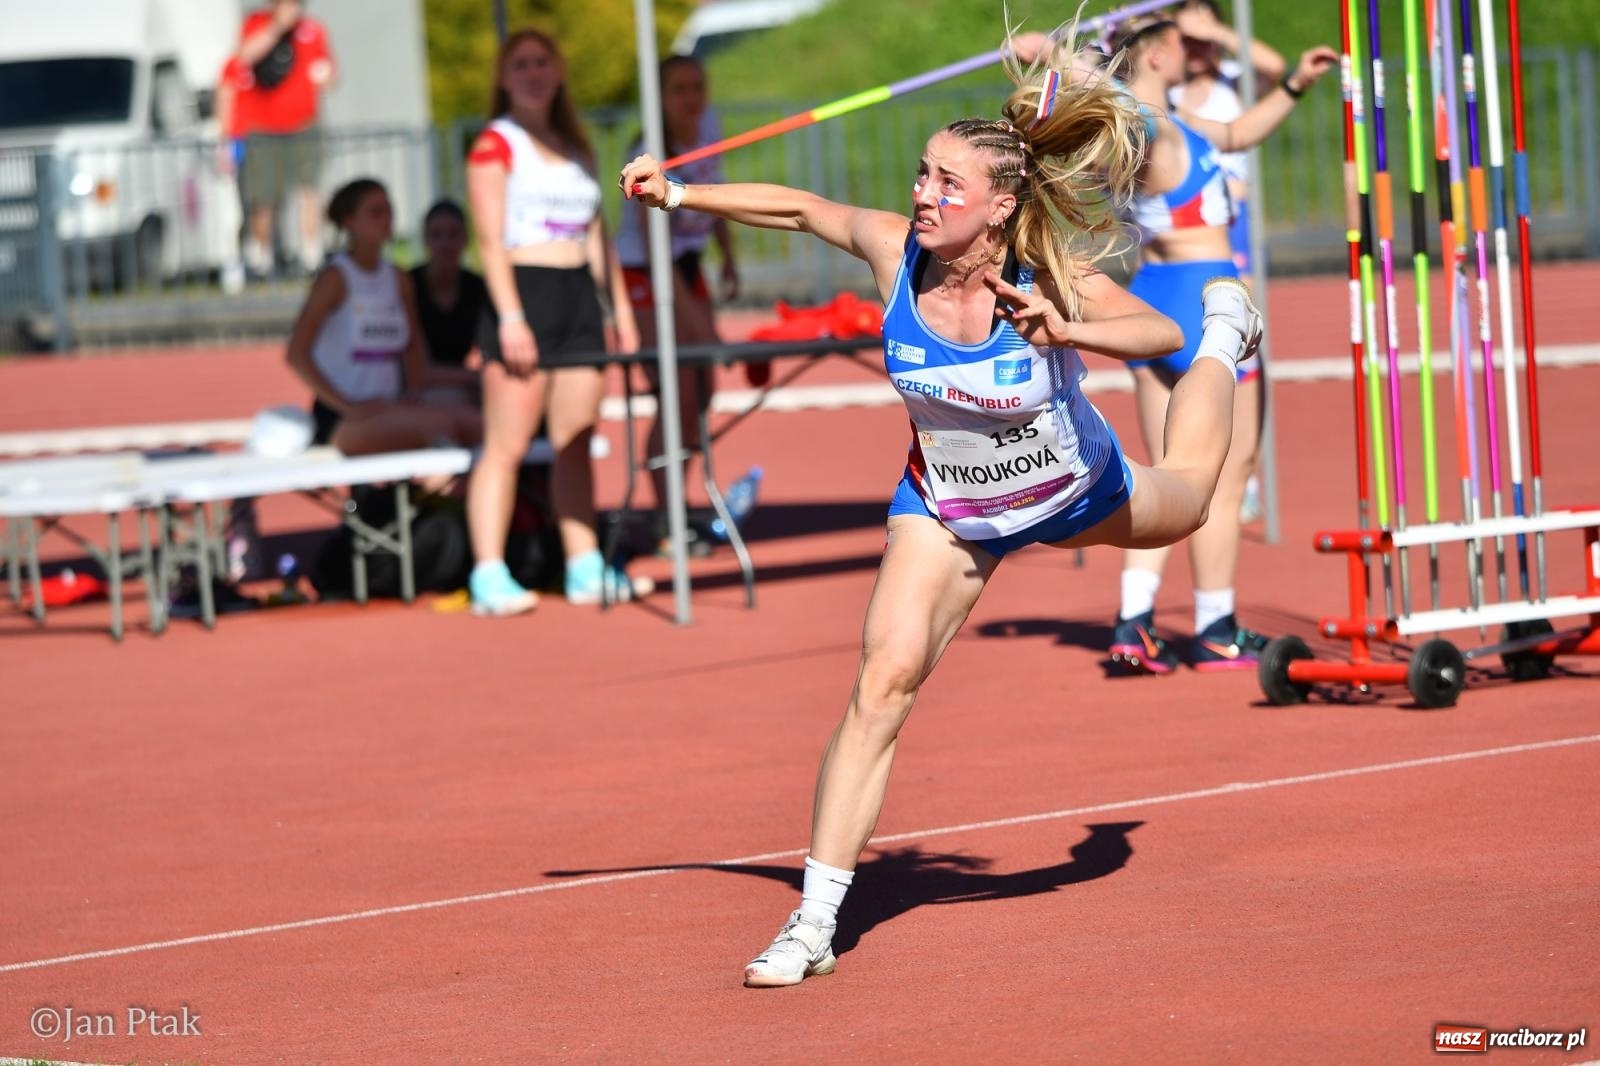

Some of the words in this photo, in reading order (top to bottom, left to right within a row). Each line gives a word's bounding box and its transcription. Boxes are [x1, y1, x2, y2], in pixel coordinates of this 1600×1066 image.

[897, 378, 942, 398] CZECH
[947, 387, 1021, 409] REPUBLIC
[990, 420, 1039, 449] 135
[931, 444, 1060, 485] VYKOUKOVÁ
